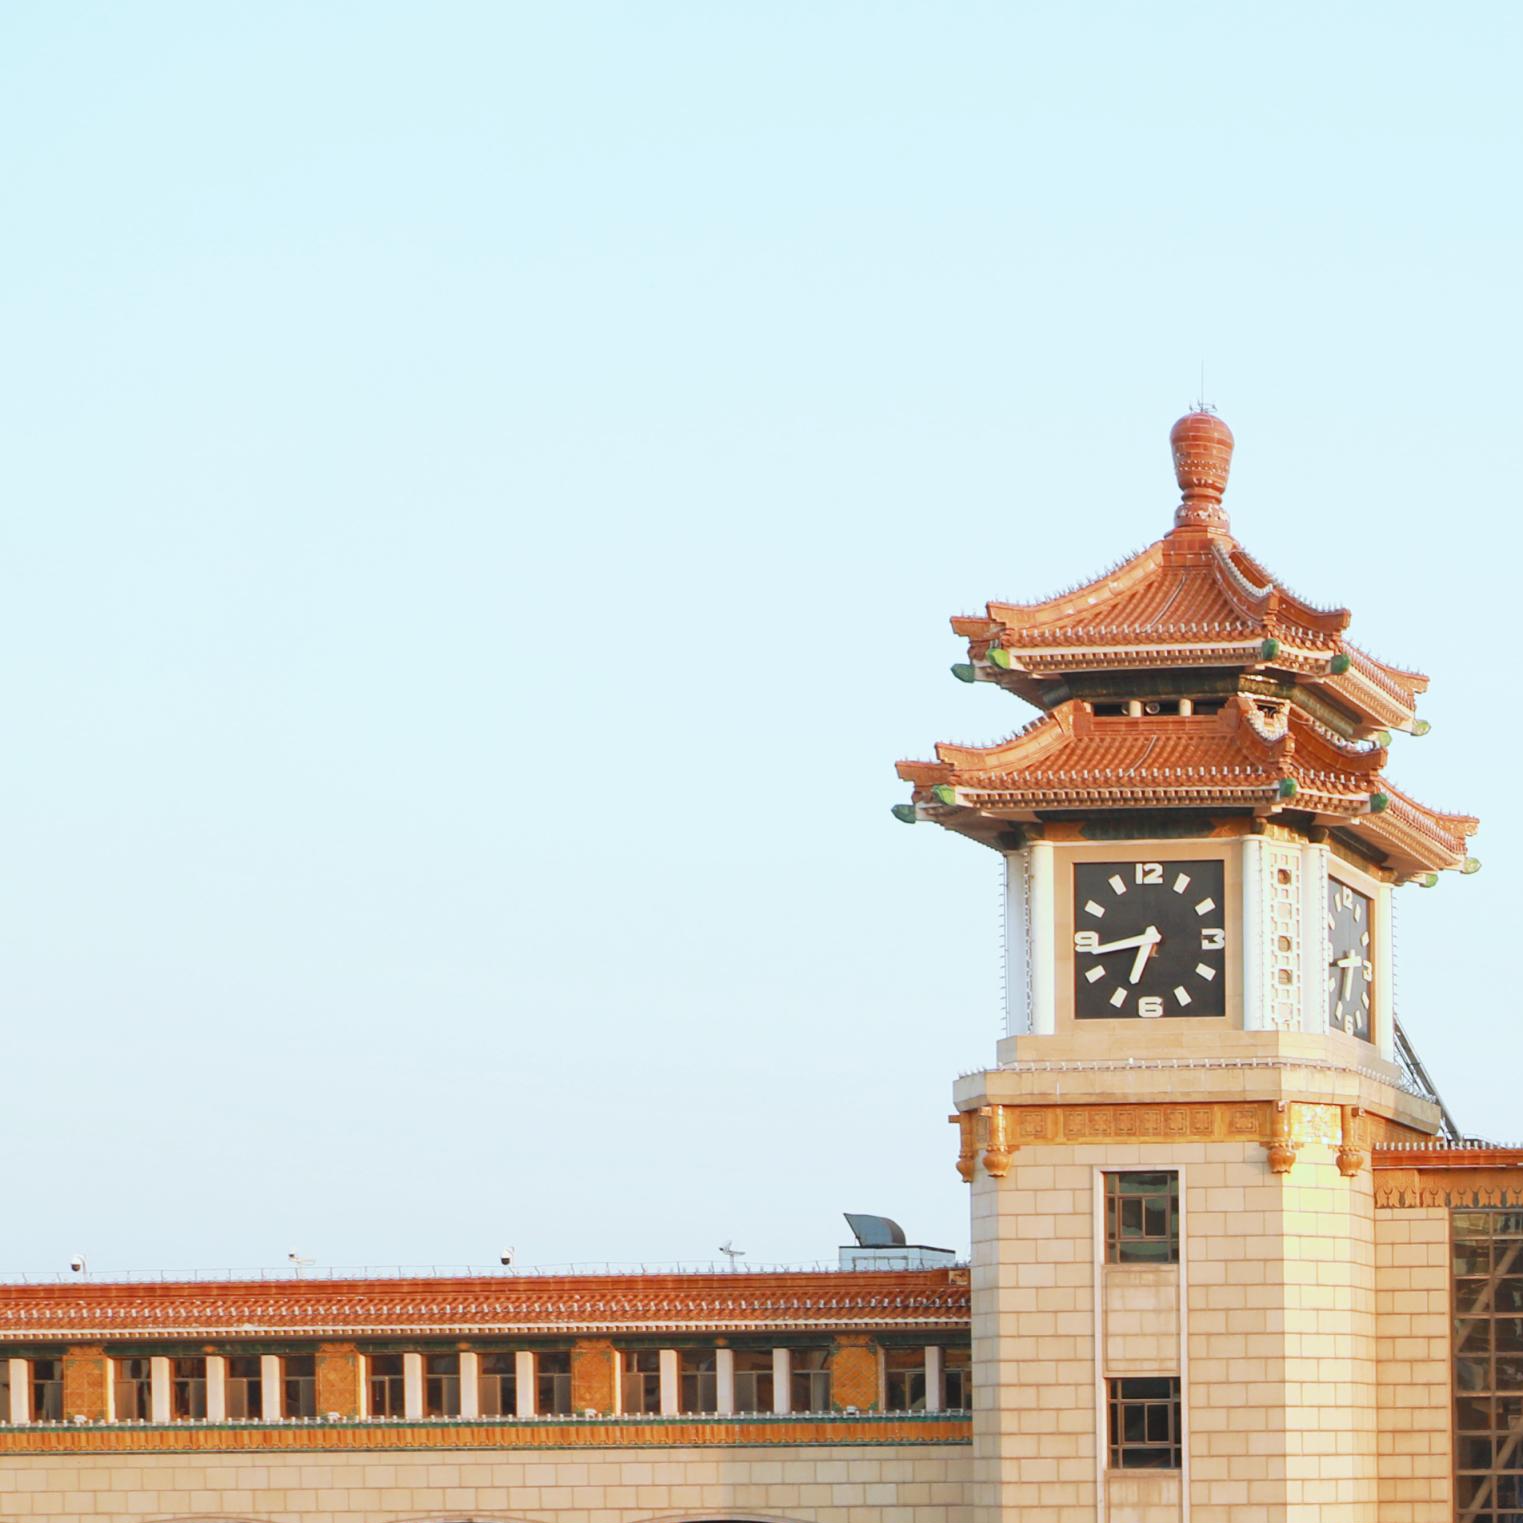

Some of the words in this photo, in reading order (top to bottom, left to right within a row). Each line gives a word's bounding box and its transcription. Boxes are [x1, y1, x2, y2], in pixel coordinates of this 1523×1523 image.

[1136, 863, 1163, 884] 12
[1342, 886, 1353, 909] 12
[1075, 931, 1099, 952] 9
[1202, 928, 1225, 950] 3
[1138, 997, 1163, 1018] 6
[1344, 1015, 1354, 1036] 6
